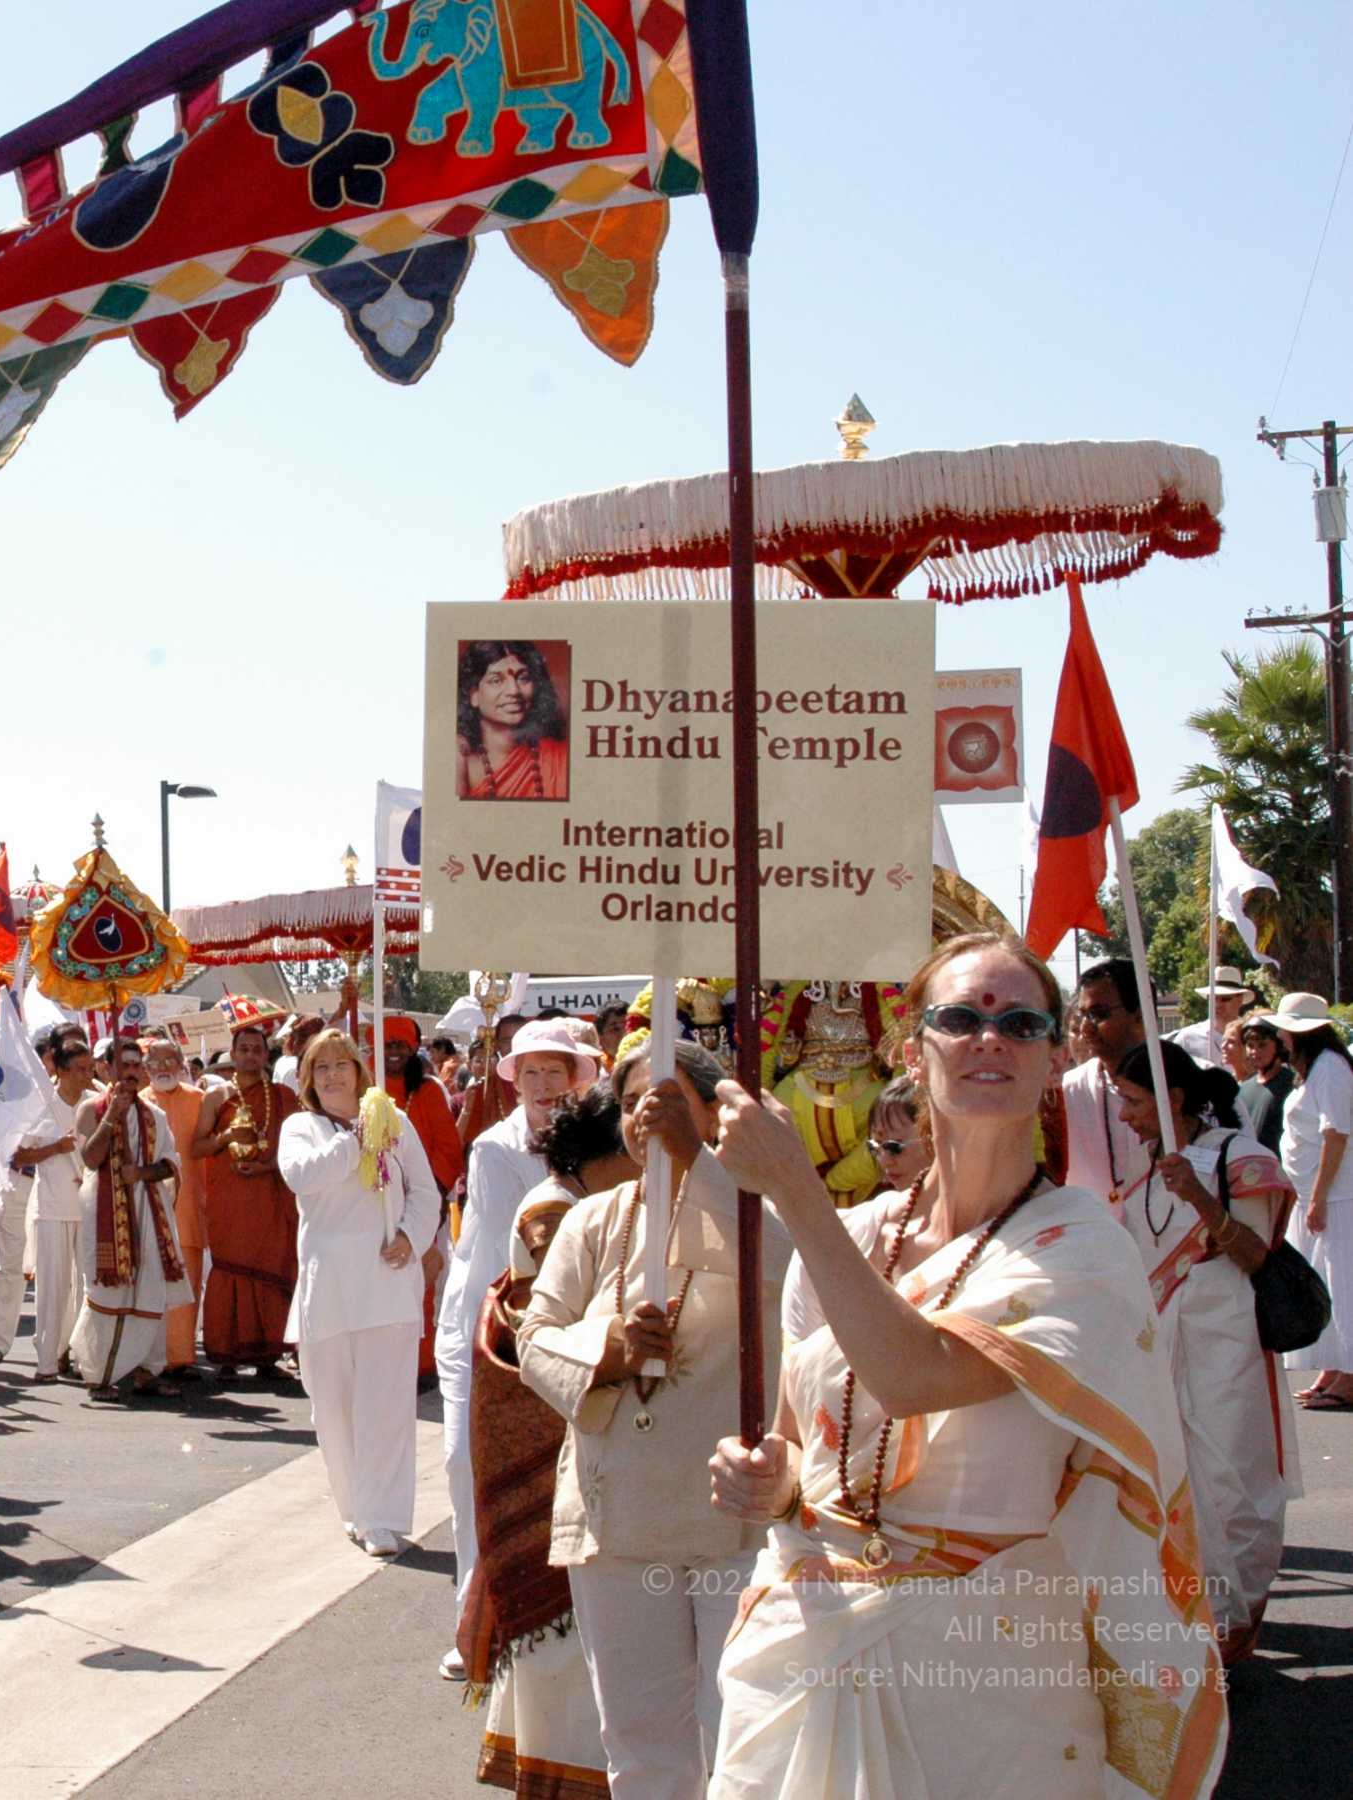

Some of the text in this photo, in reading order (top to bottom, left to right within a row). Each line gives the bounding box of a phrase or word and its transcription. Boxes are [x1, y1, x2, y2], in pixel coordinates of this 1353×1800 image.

[585, 725, 721, 760] Hindu
[562, 818, 784, 850] Internatioal
[472, 853, 875, 895] Vedic Hindu Unversity
